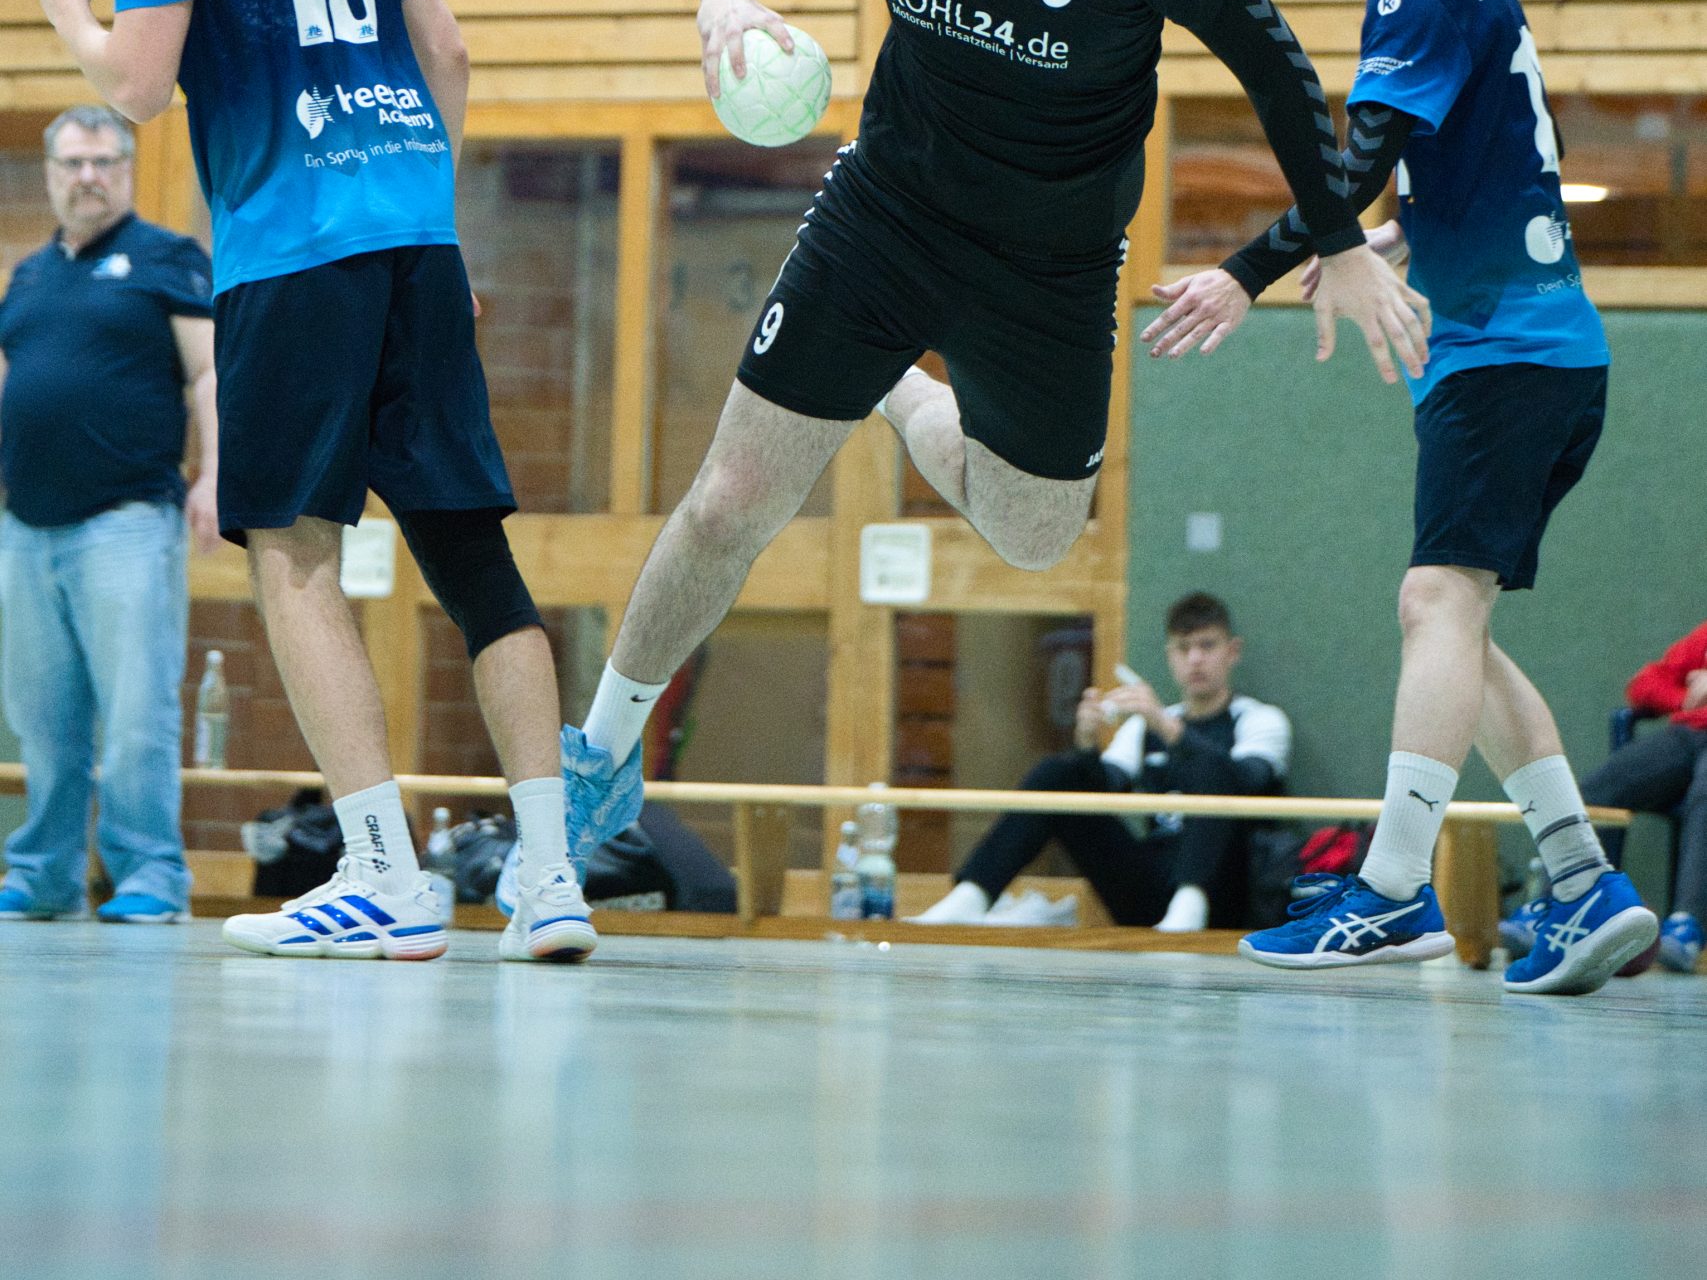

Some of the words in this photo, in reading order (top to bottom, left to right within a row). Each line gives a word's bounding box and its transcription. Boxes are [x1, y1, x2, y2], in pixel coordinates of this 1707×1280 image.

[892, 3, 934, 31] Motoren
[945, 26, 1006, 57] Ersatzteile
[1016, 50, 1069, 70] Versand
[368, 144, 384, 157] in
[385, 140, 403, 154] die
[752, 301, 784, 355] 9
[364, 814, 386, 856] CRAFT
